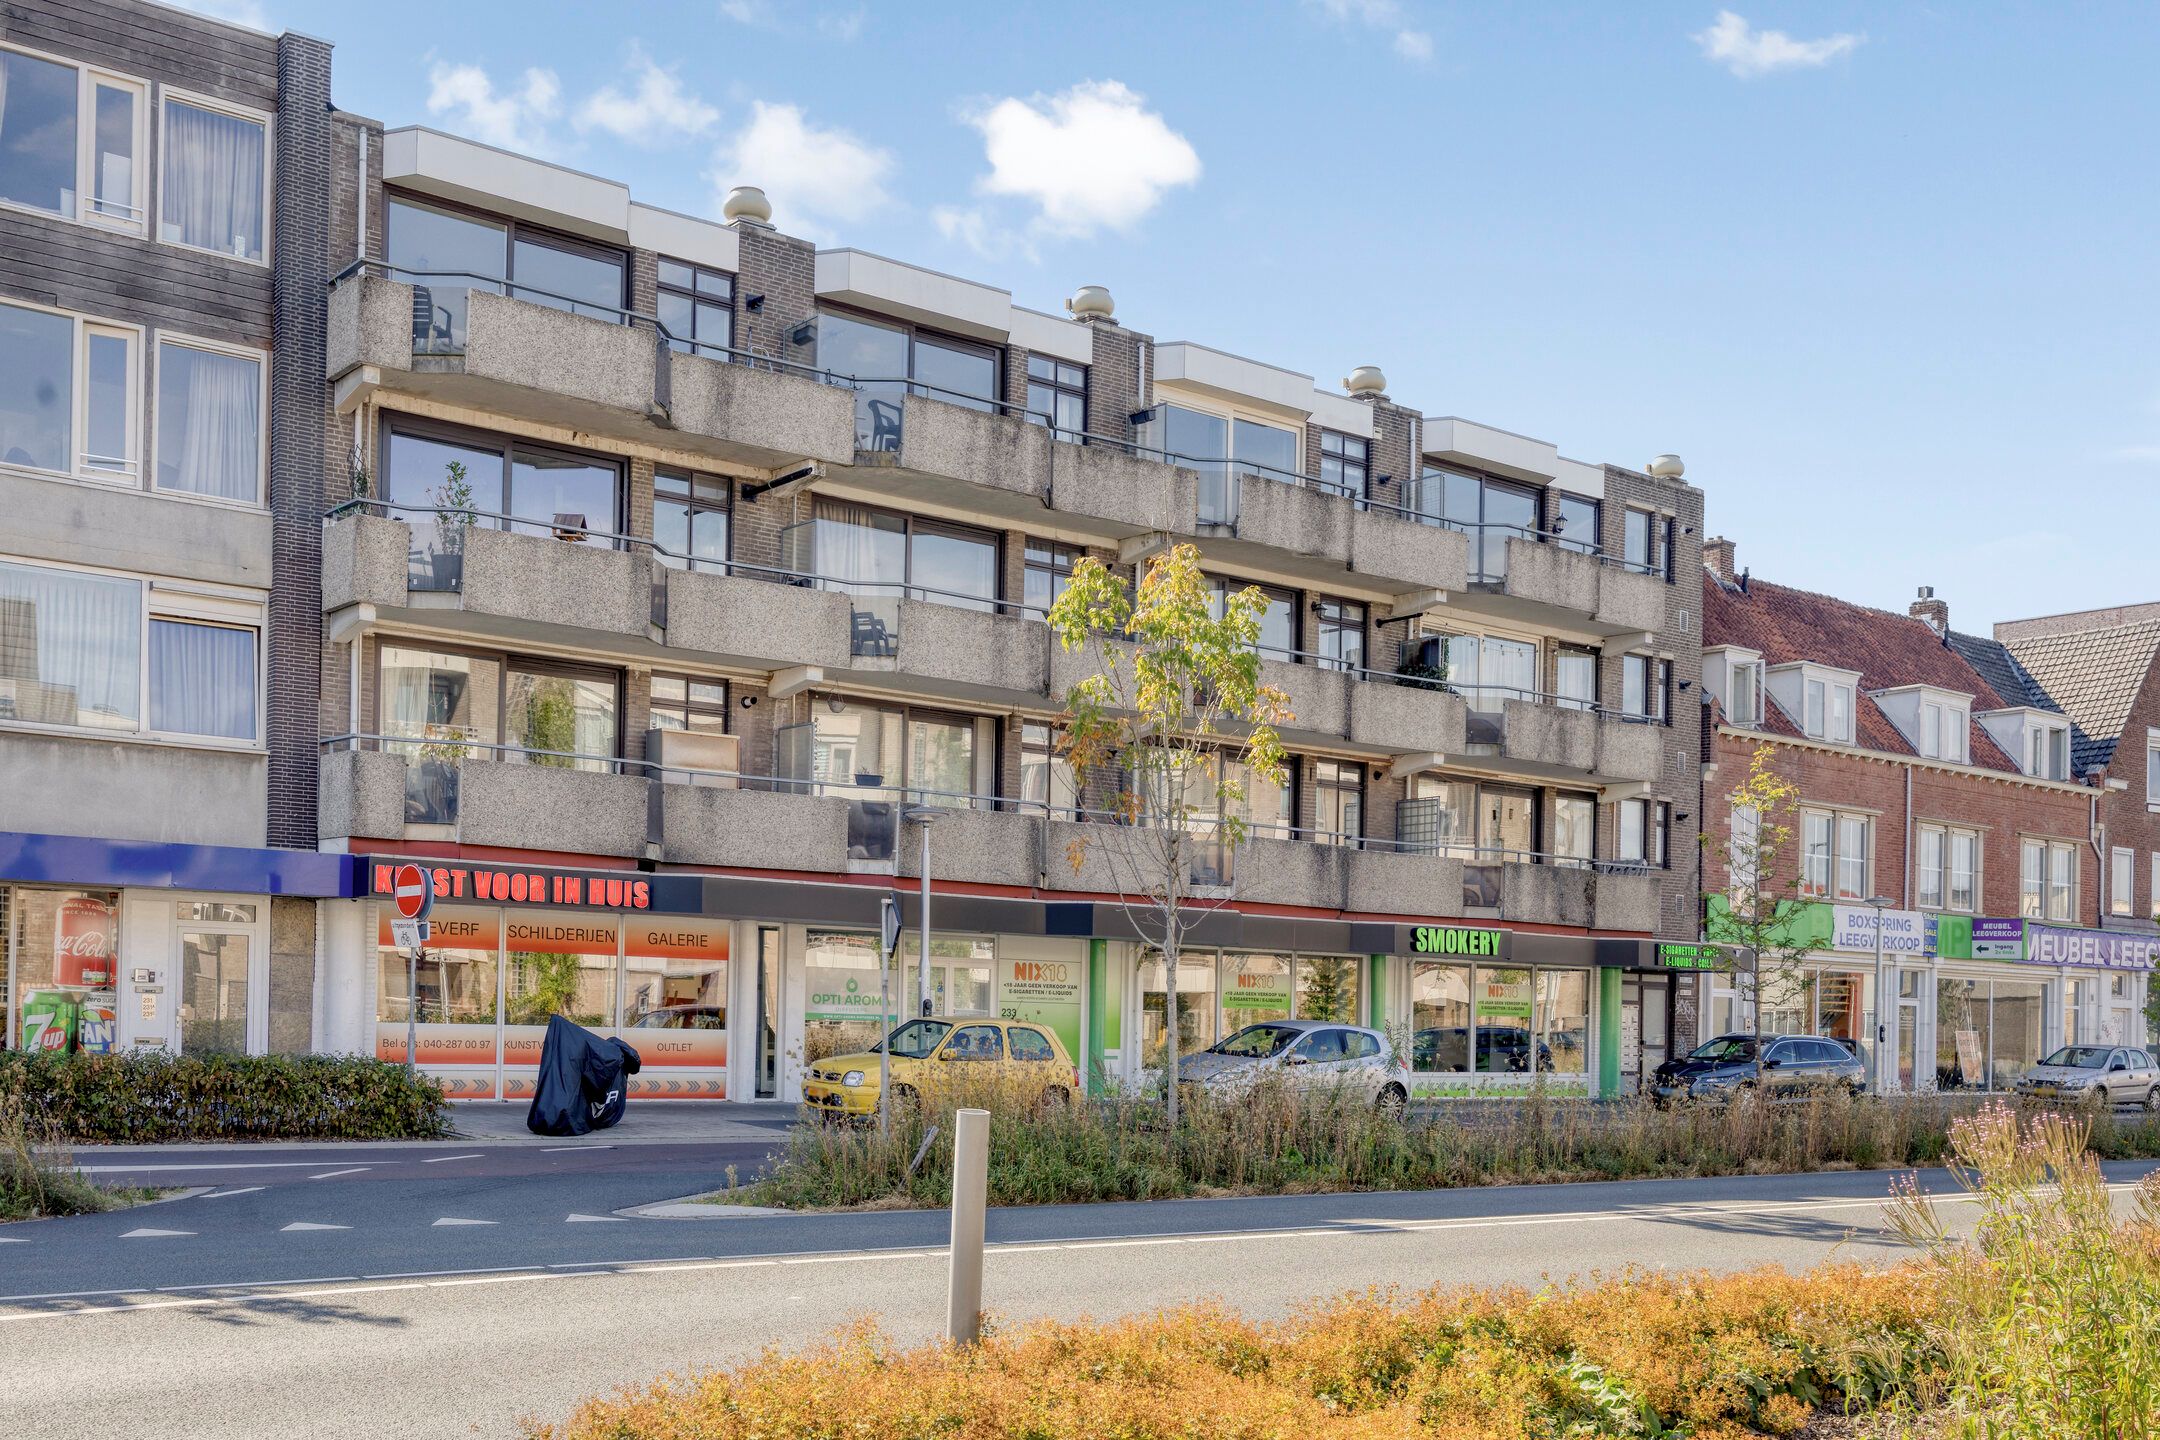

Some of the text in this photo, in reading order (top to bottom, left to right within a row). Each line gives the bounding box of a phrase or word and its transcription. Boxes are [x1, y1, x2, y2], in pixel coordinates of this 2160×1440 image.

[375, 864, 649, 909] KST VOOR IN HUIS
[508, 925, 615, 943] SCHILDERIJEN
[647, 932, 708, 947] GALERIE
[1416, 927, 1501, 956] SMOKERY
[1840, 932, 1920, 950] LEEGVRKOOP
[1660, 944, 1697, 956] E-SIGARETTEN
[1924, 945, 1937, 953] SALE
[2028, 934, 2105, 965] MEUBEL
[1665, 956, 1693, 967] E-LIQUIDS
[1015, 961, 1067, 982] NIX18
[1238, 974, 1274, 988] NIX18
[812, 993, 841, 1005] OPTI
[1001, 1008, 1017, 1017] 233
[382, 1039, 490, 1049] Bel os: 040-287 00 97
[504, 1040, 544, 1050] KUNSTV
[657, 1043, 693, 1052] OUTLET
